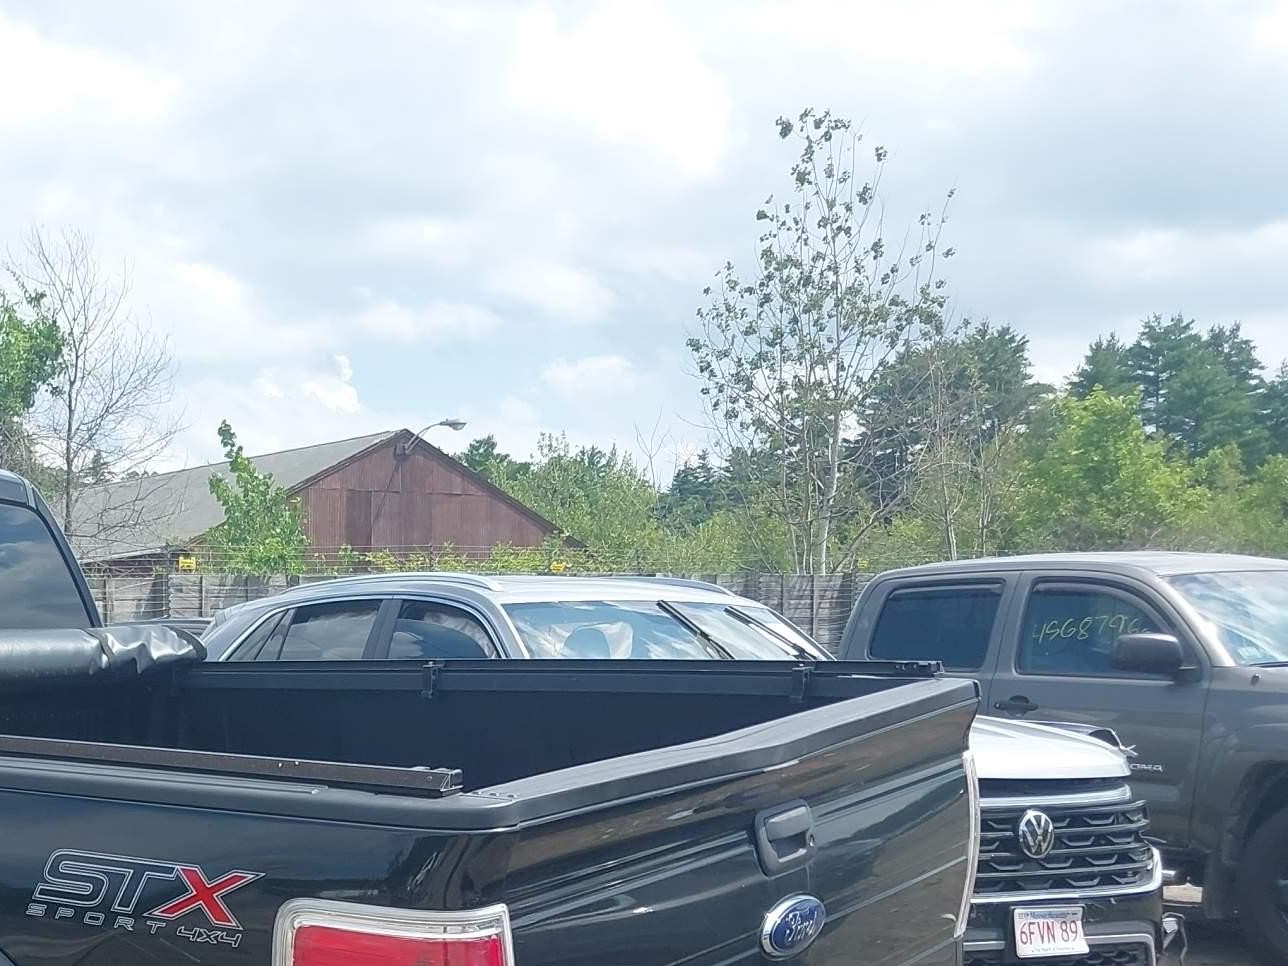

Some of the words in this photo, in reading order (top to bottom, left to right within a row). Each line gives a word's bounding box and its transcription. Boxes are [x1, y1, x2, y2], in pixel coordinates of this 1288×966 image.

[1032, 614, 1152, 645] 4568796
[32, 849, 266, 930] STX
[25, 902, 166, 935] SPORT
[1019, 921, 1056, 945] 6FVN
[1060, 920, 1078, 942] 89
